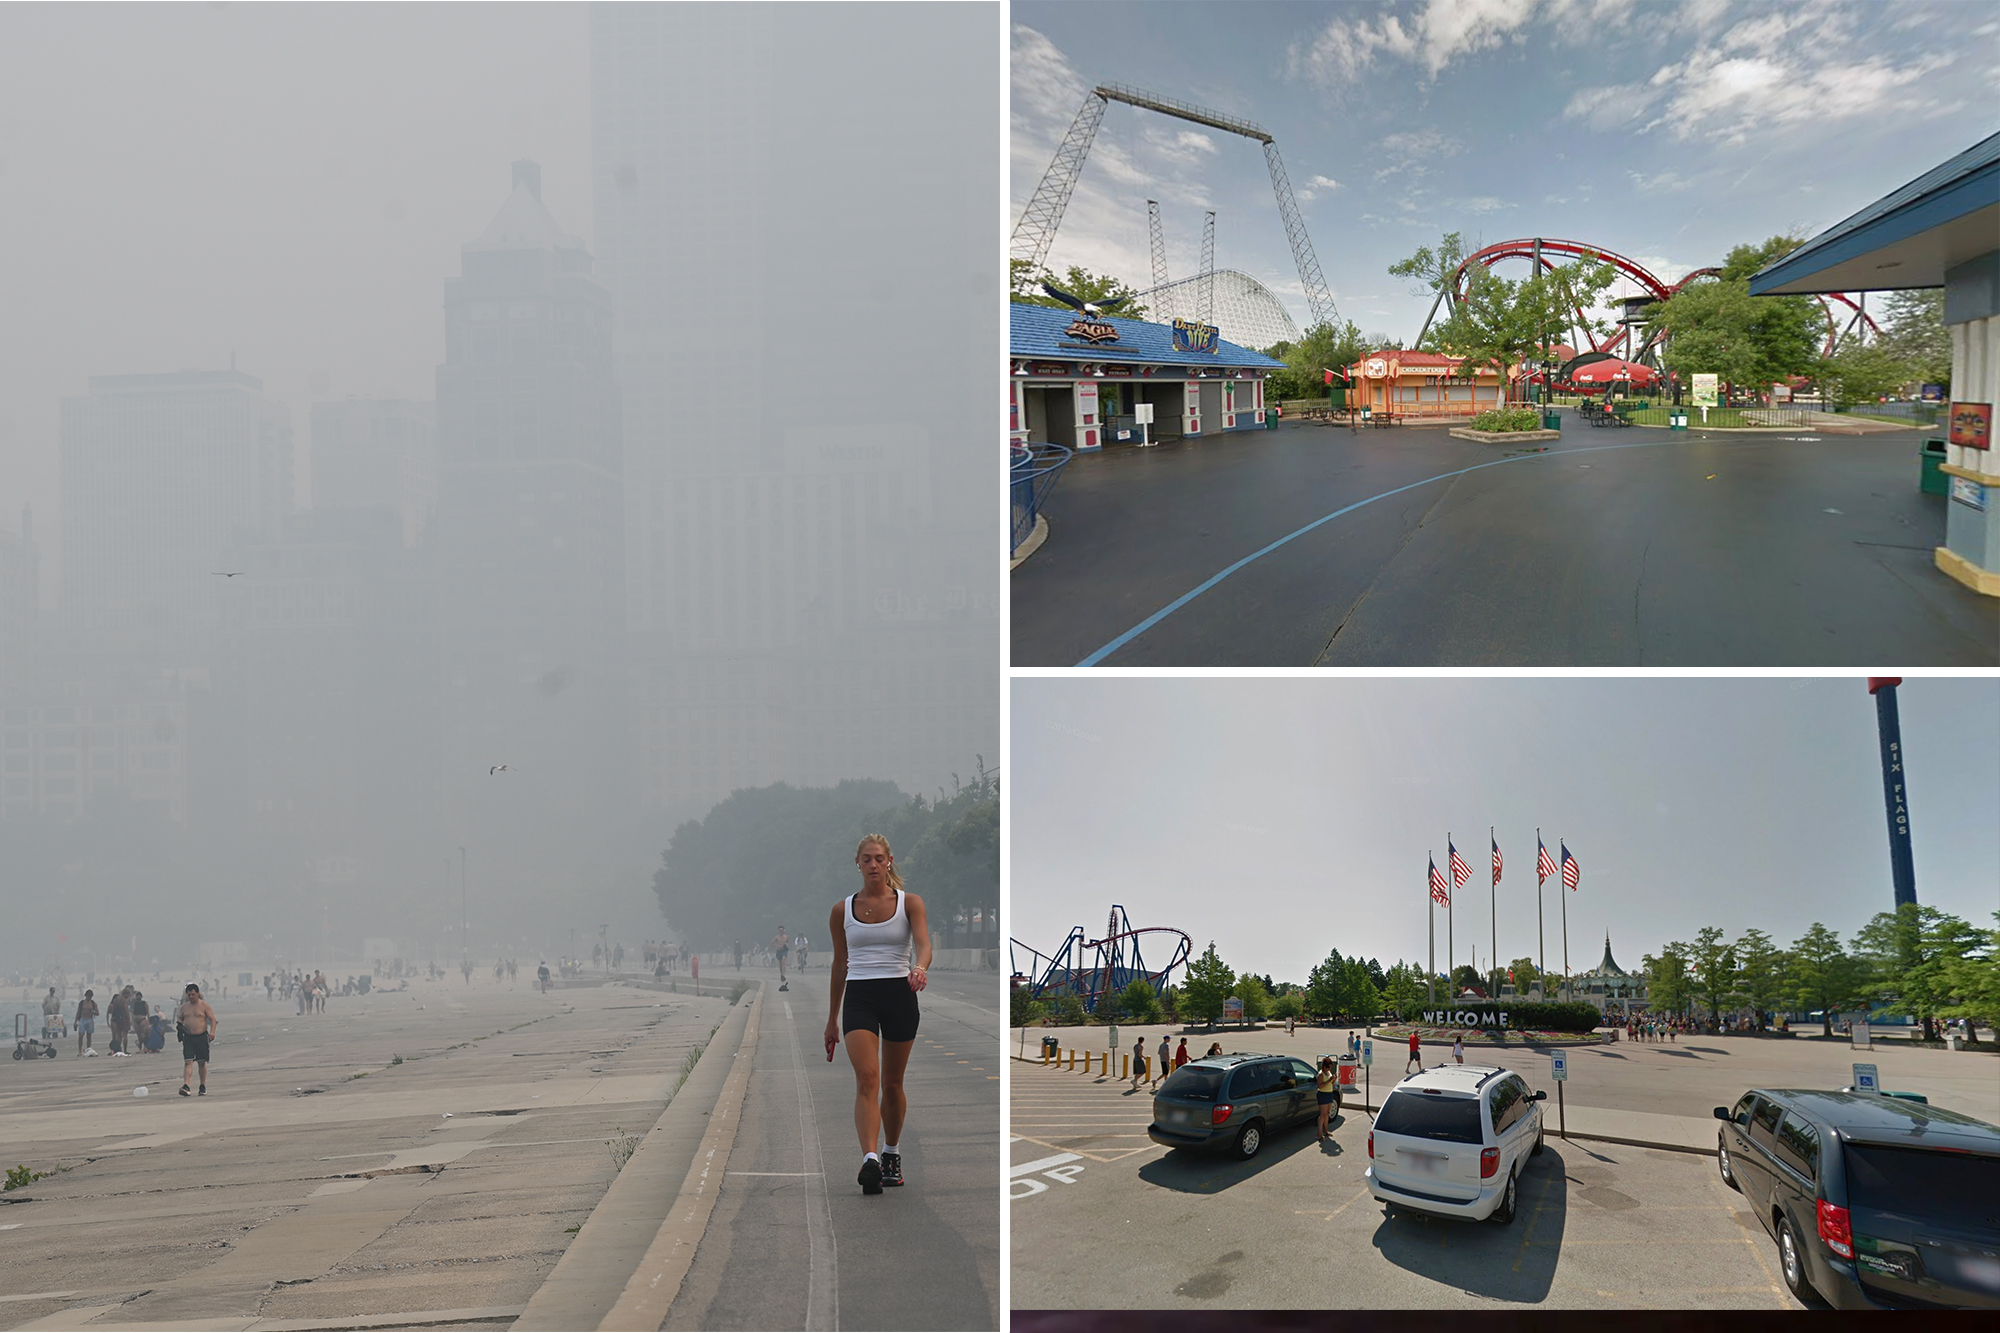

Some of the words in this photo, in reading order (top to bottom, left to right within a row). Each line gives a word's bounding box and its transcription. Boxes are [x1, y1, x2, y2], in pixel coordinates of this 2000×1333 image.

[818, 445, 884, 461] WESTIN
[874, 587, 931, 613] The
[1890, 742, 1900, 772] SIX
[1894, 784, 1907, 835] FLAGS
[1423, 1010, 1509, 1027] WELCOME
